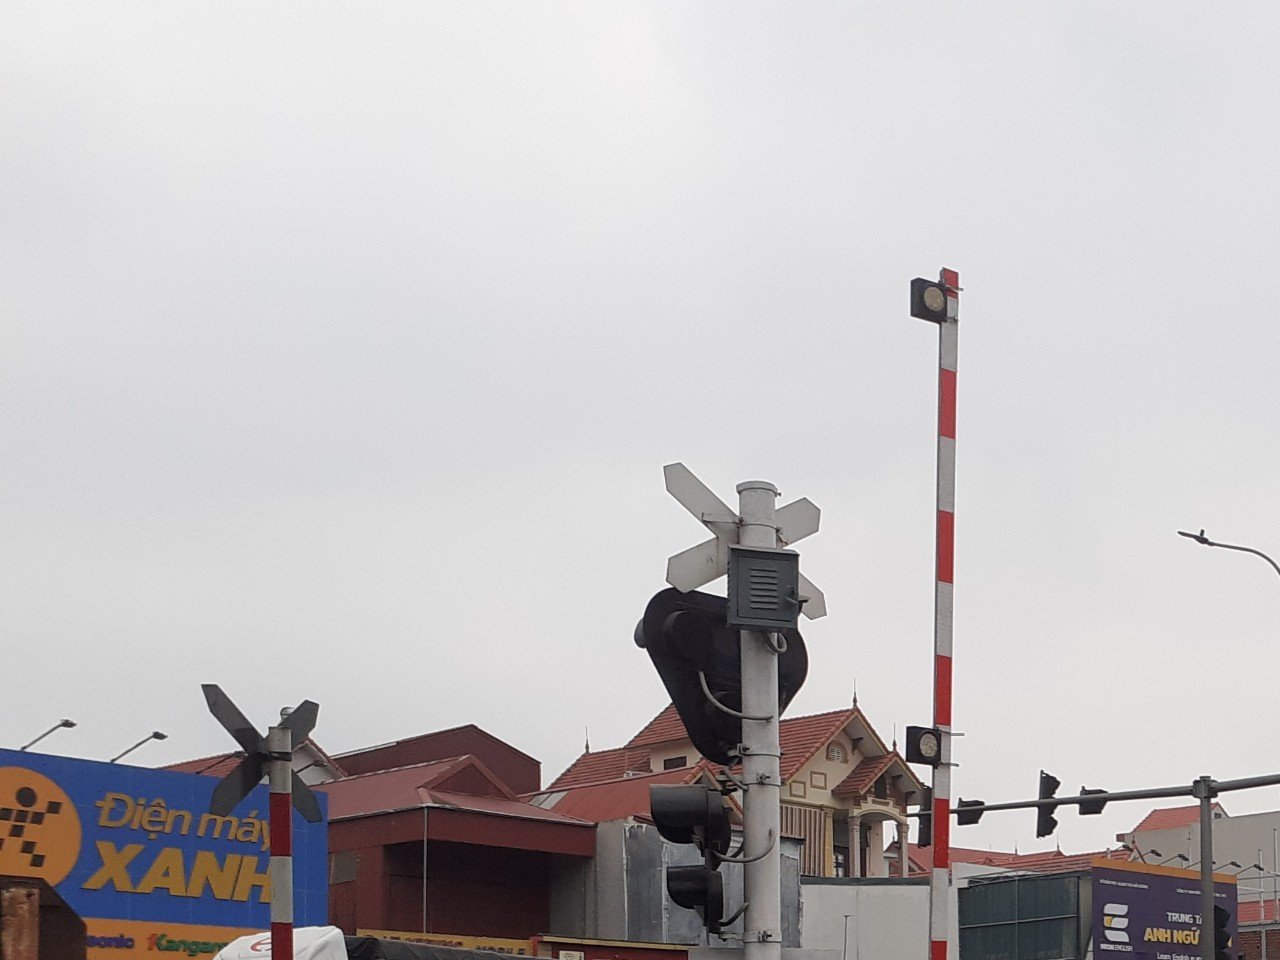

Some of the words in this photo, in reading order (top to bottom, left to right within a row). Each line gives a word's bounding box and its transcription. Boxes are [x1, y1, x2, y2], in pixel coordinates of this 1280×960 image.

[95, 791, 193, 840] Điện
[197, 810, 270, 851] máy
[81, 840, 271, 904] XANH
[1144, 927, 1172, 943] ANH
[1166, 912, 1193, 924] TRUNG
